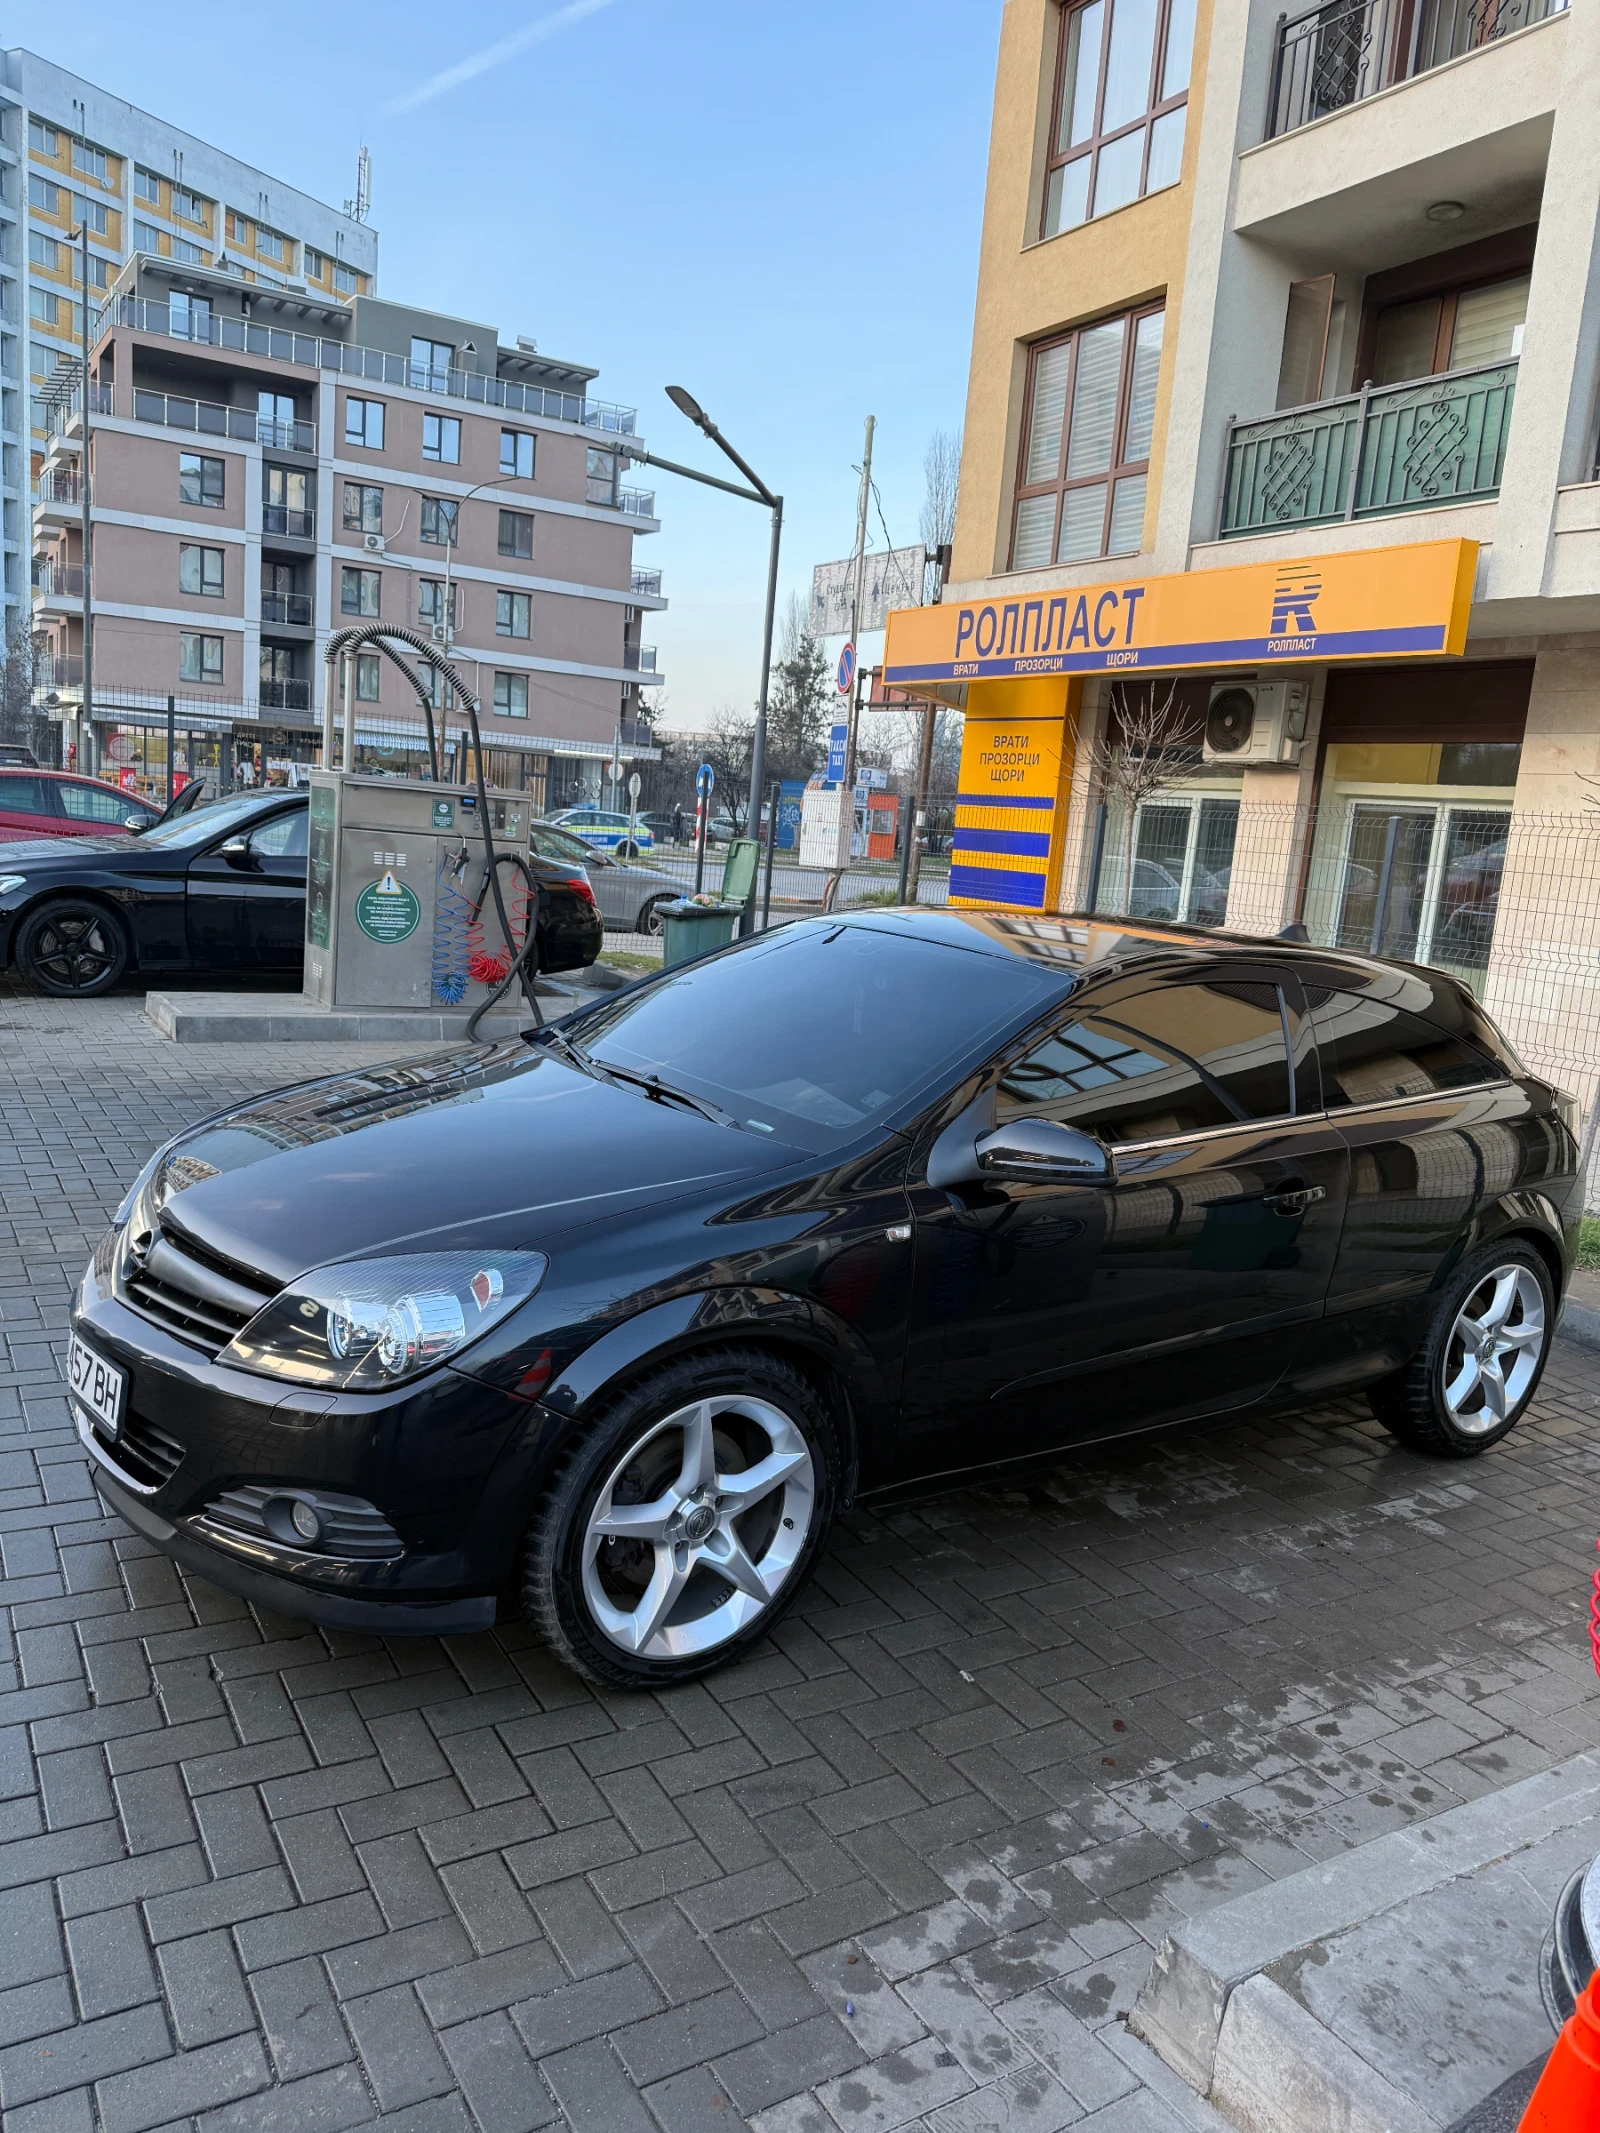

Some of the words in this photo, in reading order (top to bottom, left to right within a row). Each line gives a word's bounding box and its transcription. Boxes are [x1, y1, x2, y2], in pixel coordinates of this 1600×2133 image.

[955, 587, 1145, 659] РОЛПЛАСТ
[1267, 638, 1317, 653] РОЛПЛАСТ
[953, 663, 979, 676] ВРАТИ
[1014, 657, 1063, 672] ПРОЗОРЦИ
[1106, 651, 1139, 667] ЩОРИ
[993, 735, 1029, 749] ВРАТИ
[979, 752, 1040, 767] ПРОЗОРЦИ
[990, 769, 1025, 784] ЩОРИ
[93, 1362, 118, 1420] BH
